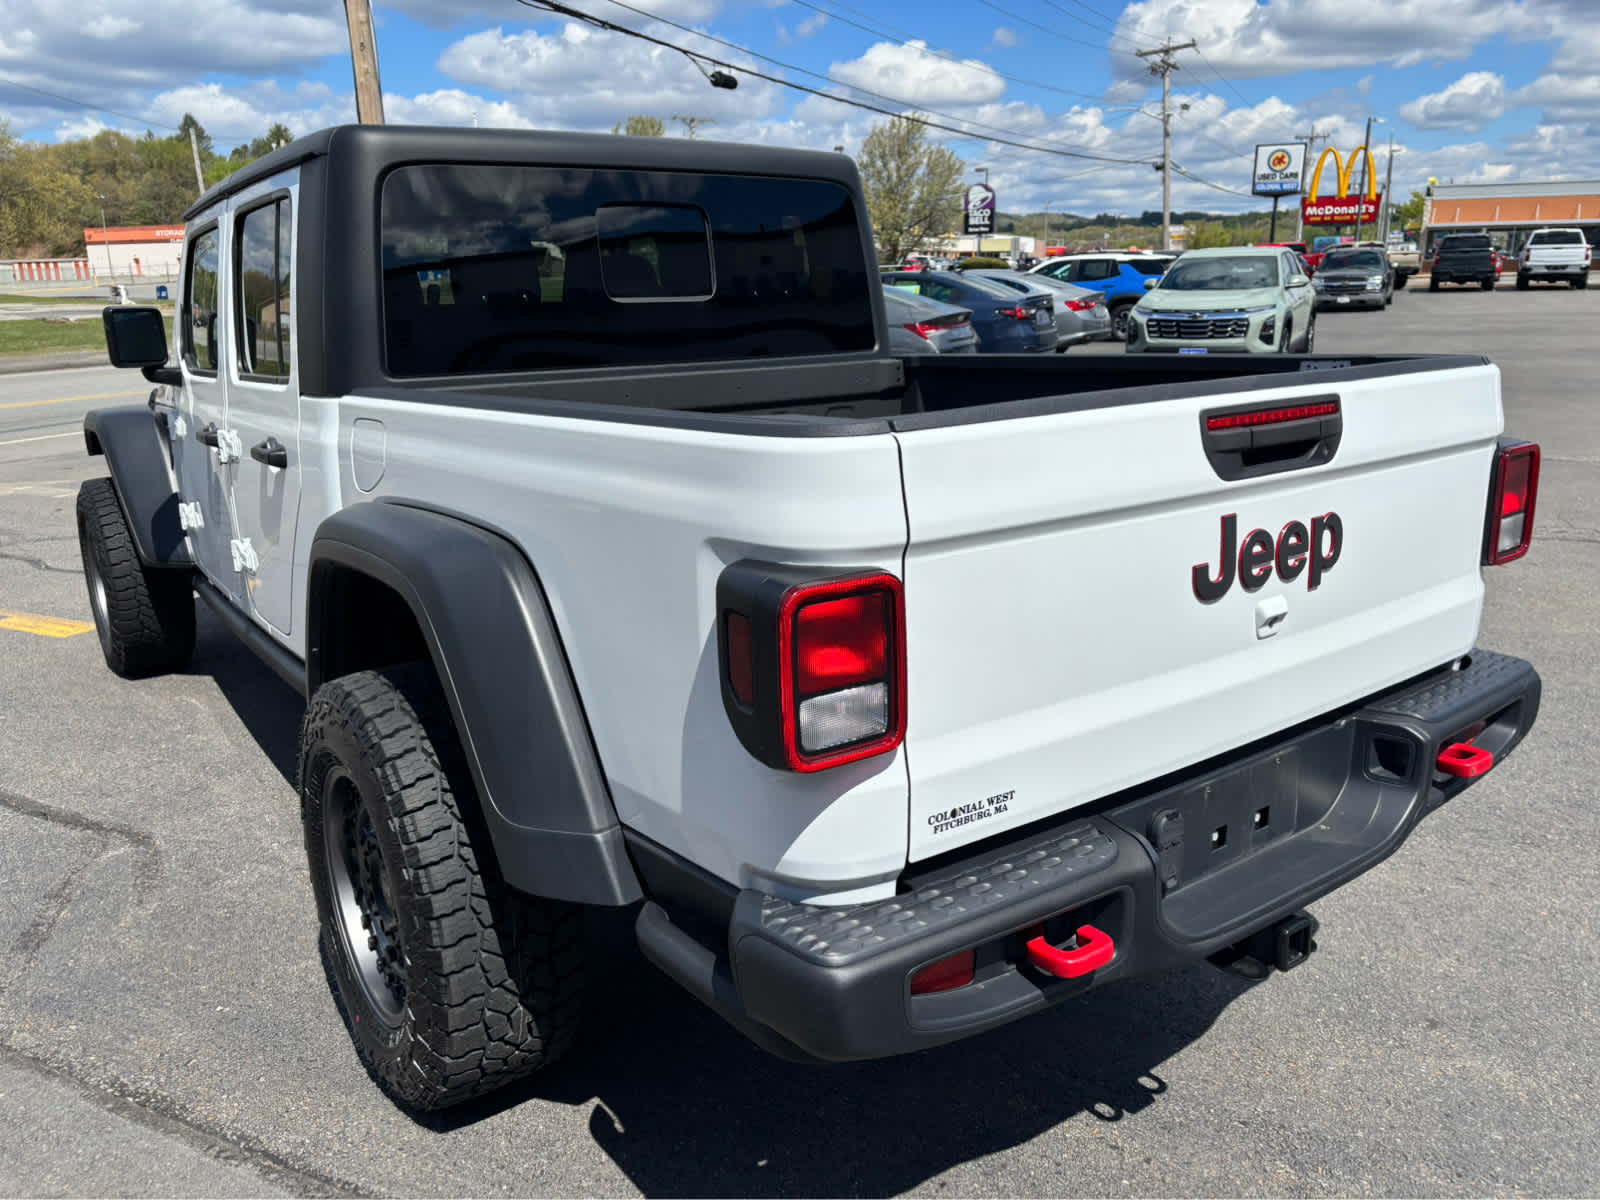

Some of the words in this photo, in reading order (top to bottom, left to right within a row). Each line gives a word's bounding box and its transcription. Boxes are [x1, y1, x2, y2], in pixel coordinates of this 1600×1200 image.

[968, 208, 991, 217] TACO
[969, 216, 990, 224] BELL
[155, 229, 185, 237] STORAG
[1192, 511, 1343, 605] Jeep
[986, 790, 1016, 808] WEST
[933, 808, 992, 835] FITCHBURG,
[994, 803, 1008, 815] MA
